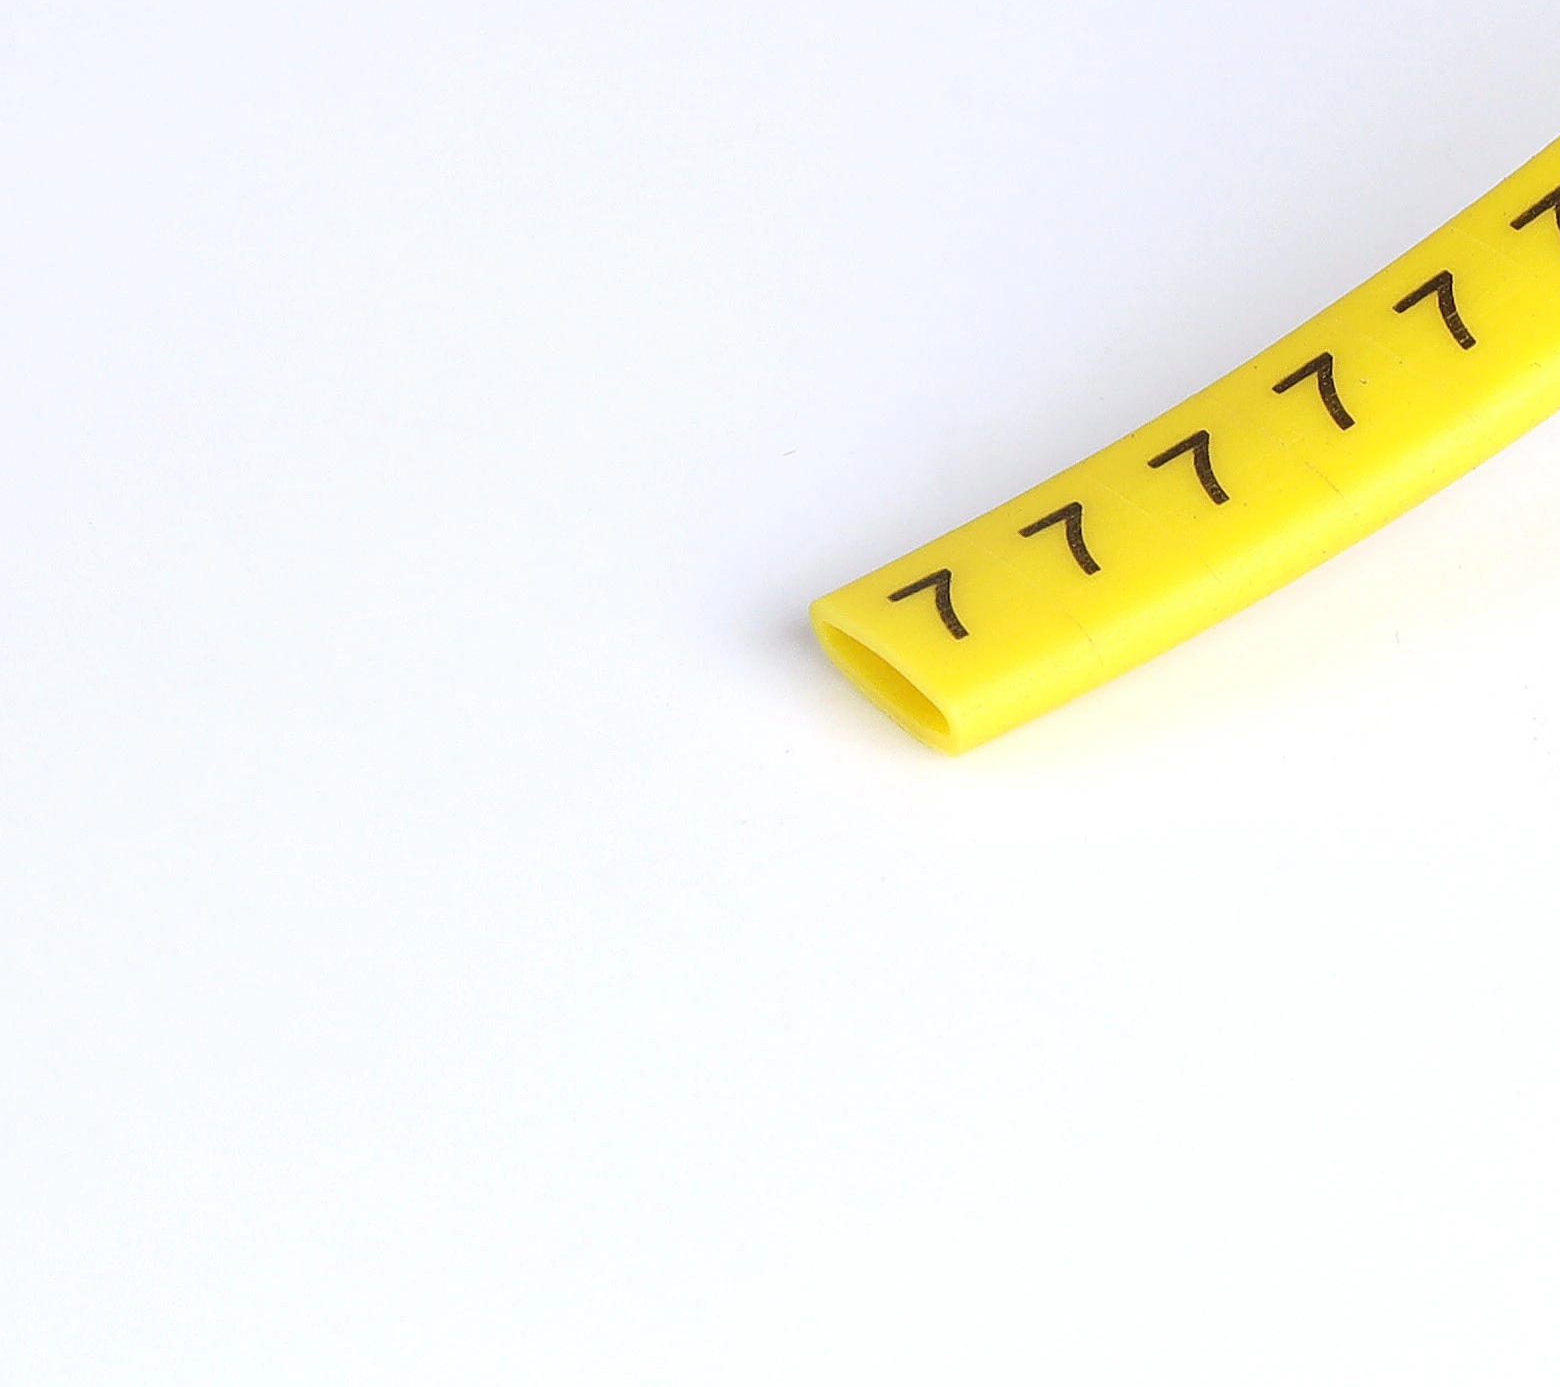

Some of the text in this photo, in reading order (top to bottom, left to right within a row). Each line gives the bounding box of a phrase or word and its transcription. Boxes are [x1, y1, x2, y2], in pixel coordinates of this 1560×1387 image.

[887, 567, 970, 641] 7
[1018, 500, 1102, 576] 7
[1146, 428, 1231, 506] 7
[1270, 350, 1357, 432] 7
[1391, 269, 1478, 351] 7
